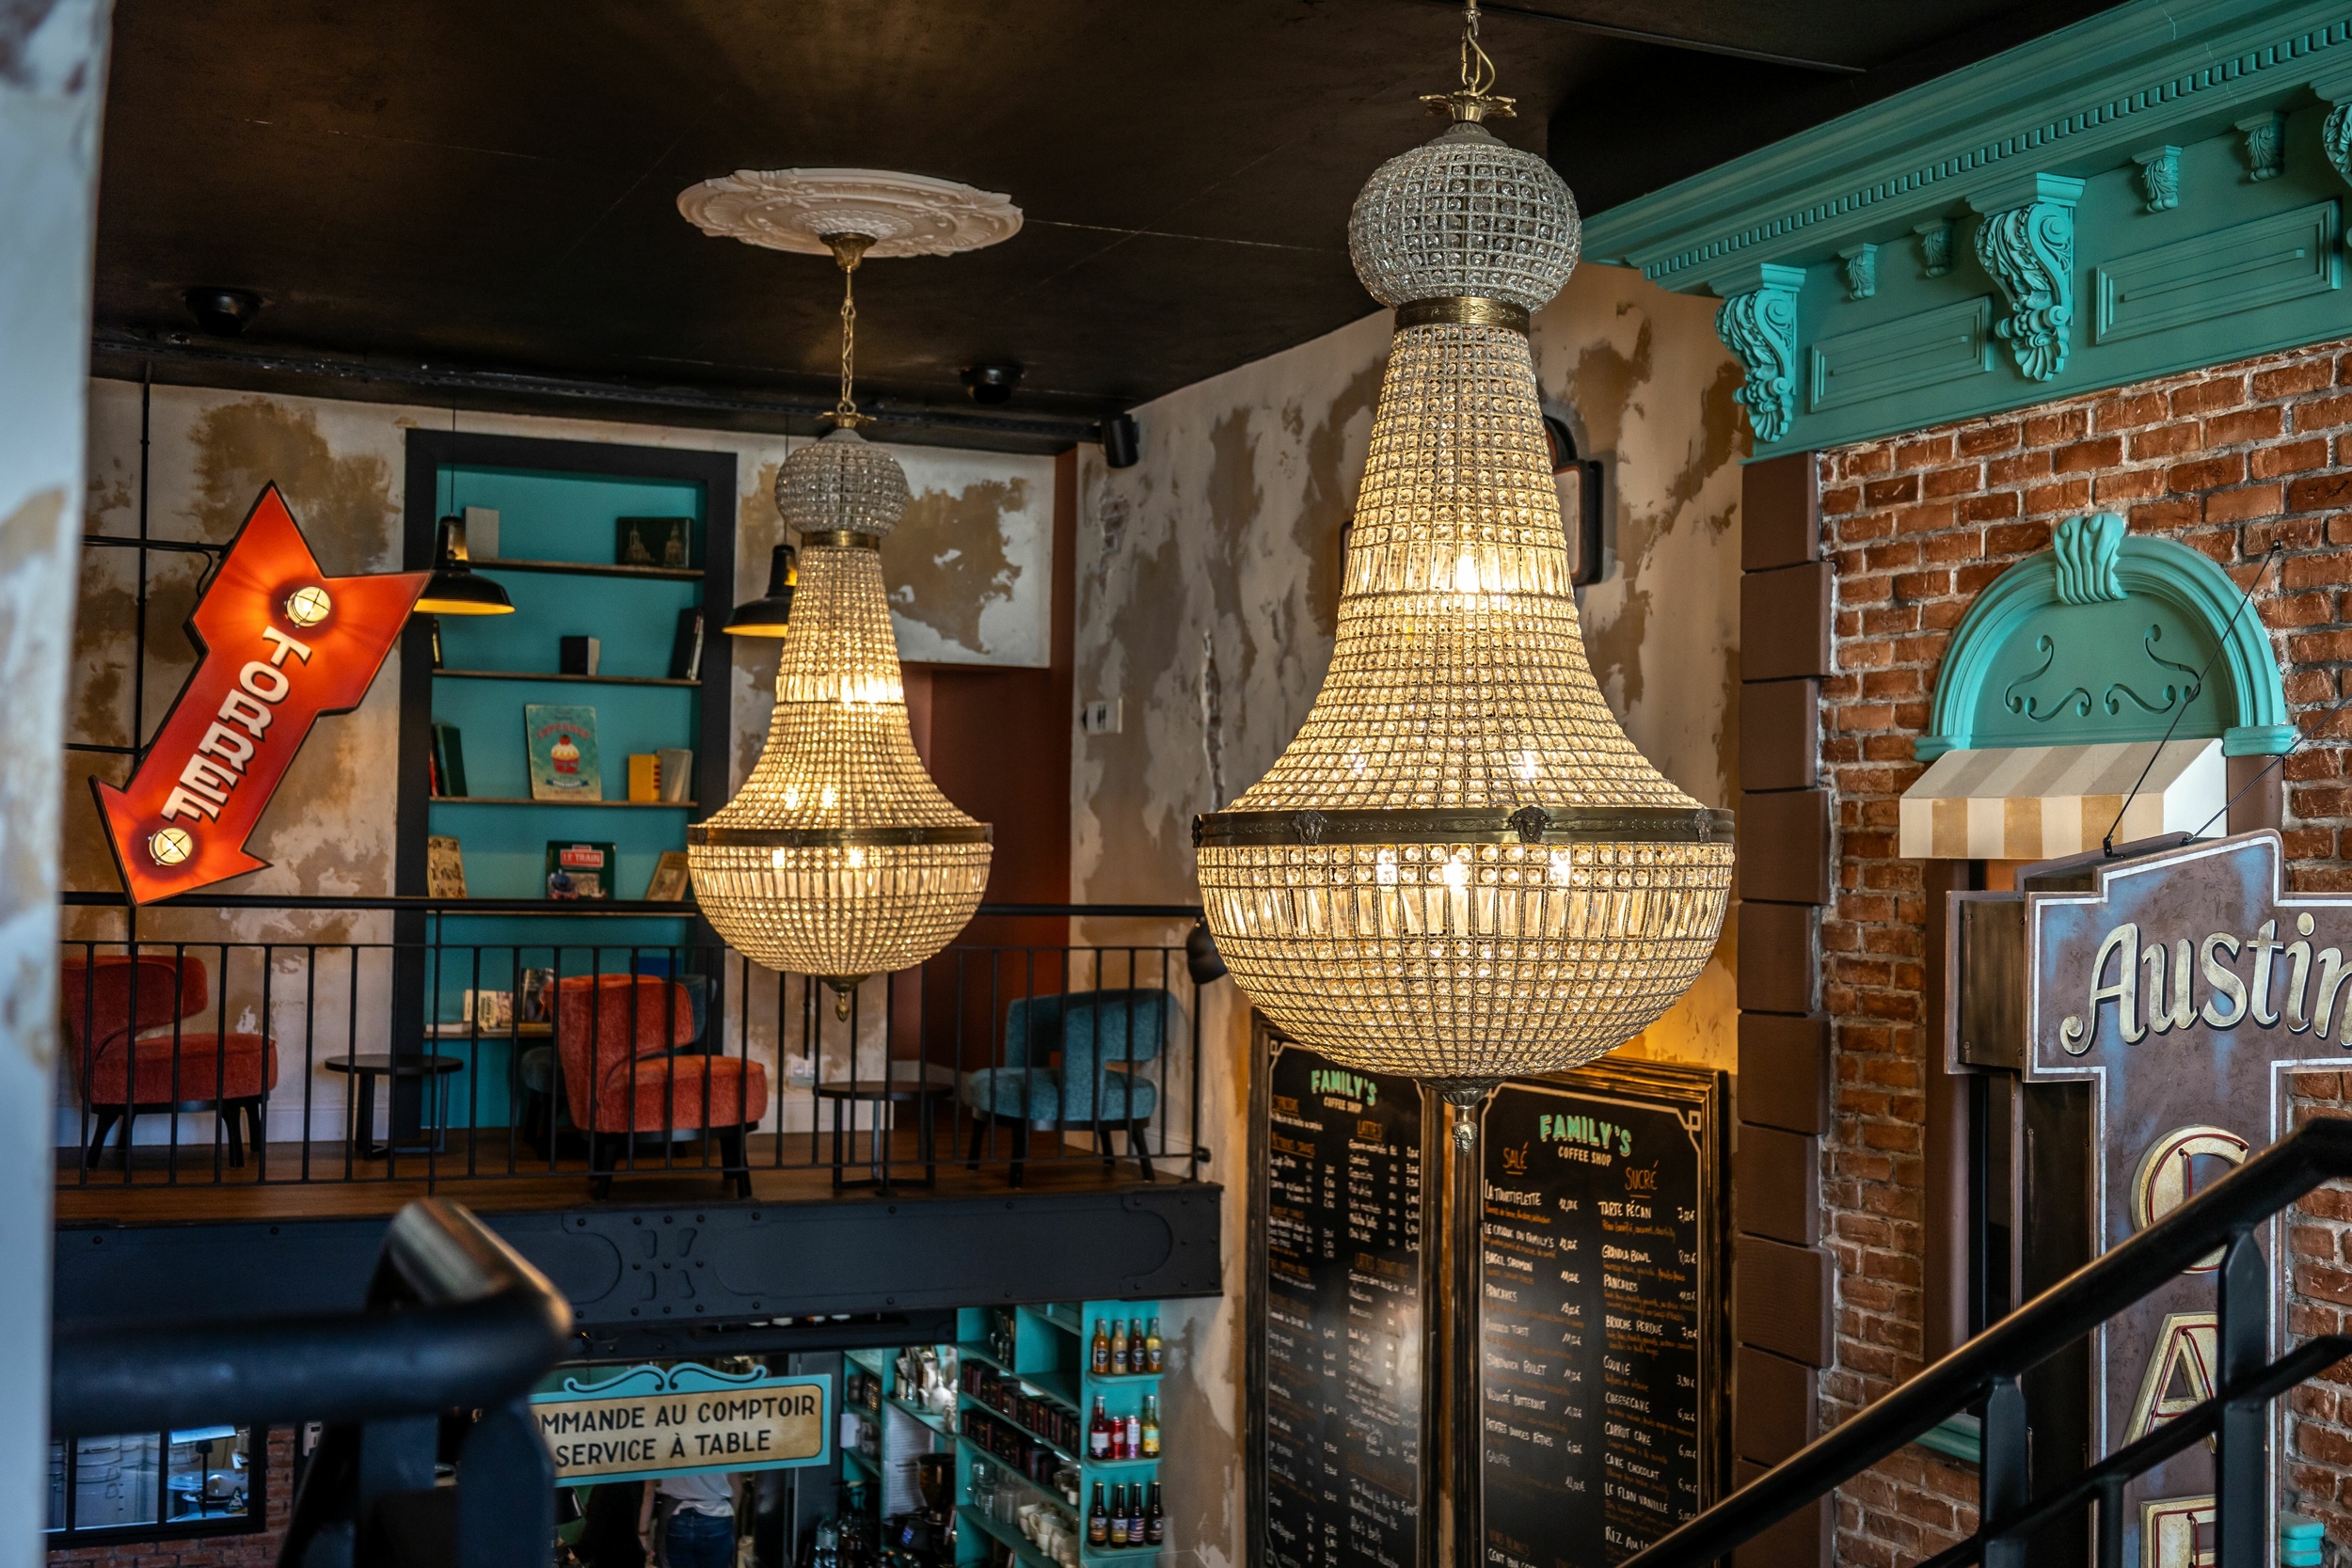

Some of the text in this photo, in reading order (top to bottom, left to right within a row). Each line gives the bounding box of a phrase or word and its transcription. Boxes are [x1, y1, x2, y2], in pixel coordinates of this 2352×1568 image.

[161, 626, 311, 822] TORREF
[2060, 912, 2352, 1055] Austin
[1311, 1069, 1377, 1107] FAMILY'S
[1323, 1096, 1347, 1110] COFFEE
[1539, 1114, 1632, 1157] FAMILY'S
[1502, 1142, 1528, 1169] SALÉ
[1558, 1146, 1613, 1166] COFFEE SHOP
[1625, 1160, 1658, 1191] SUCRÉ
[1597, 1200, 1624, 1218] TARTE
[1626, 1199, 1652, 1219] PÉCAN
[1629, 1247, 1652, 1264] BOWL
[1603, 1274, 1639, 1293] PANCAKES
[1636, 1319, 1663, 1337] PERDUE
[1603, 1354, 1631, 1376] COOKIE
[655, 1404, 686, 1427] AU
[698, 1395, 815, 1424] COMPTOIR
[1605, 1391, 1650, 1414] CHEESECAKE
[1605, 1421, 1631, 1439] CARROT
[1634, 1430, 1652, 1447] CAKE
[555, 1430, 771, 1468] SERVICE À TABLE
[1605, 1452, 1625, 1469] CAKE
[1628, 1460, 1661, 1481] CHOCOLAT
[1605, 1481, 1615, 1497] LE
[1617, 1484, 1637, 1503] FLAN
[1638, 1494, 1668, 1515] VANILLE
